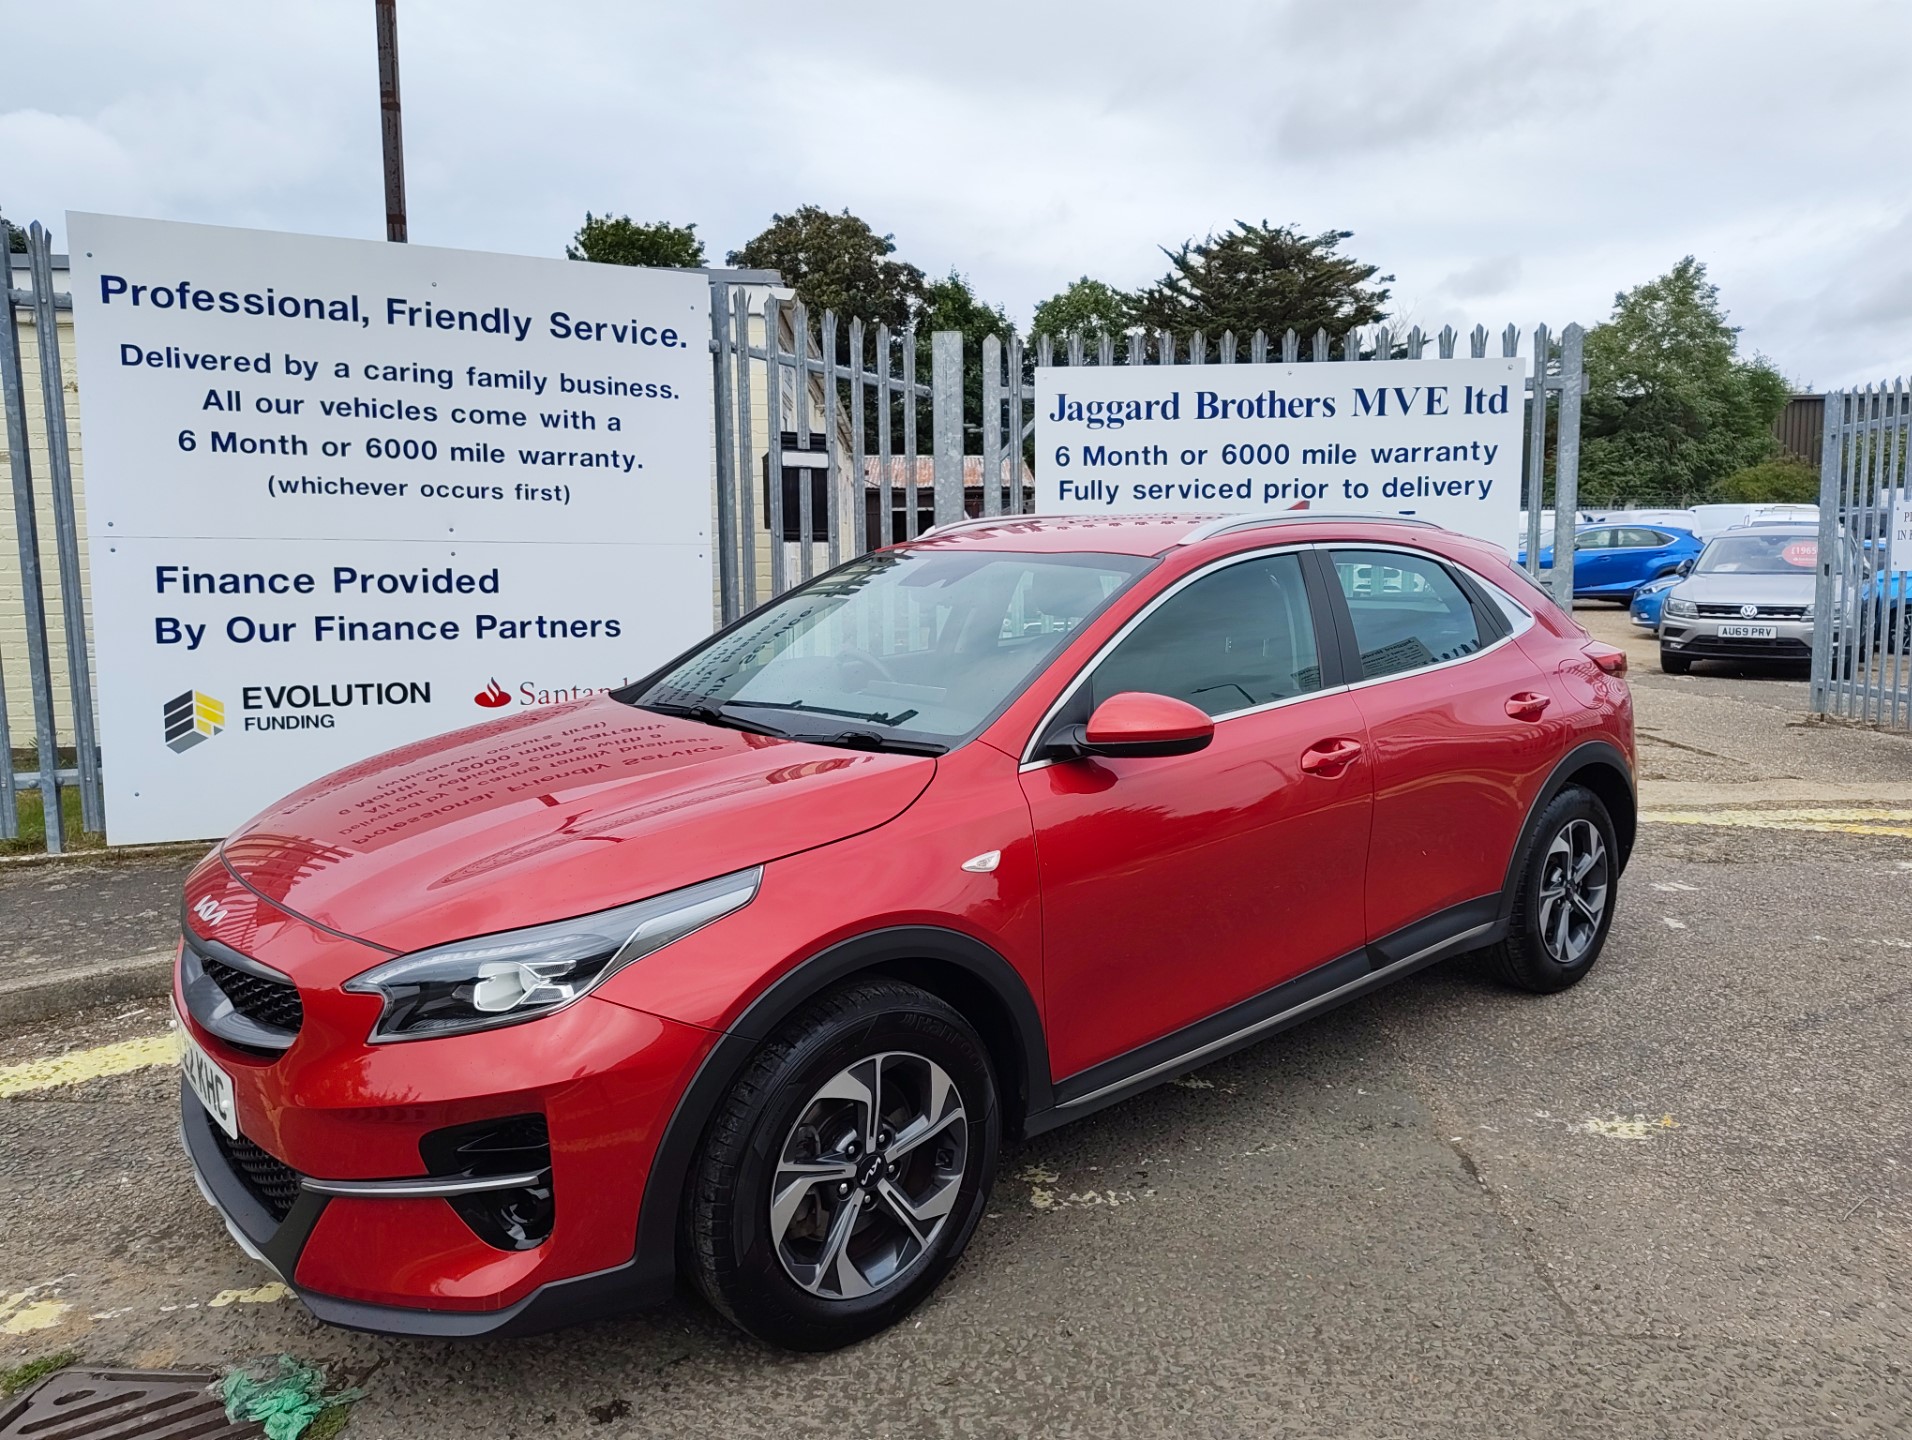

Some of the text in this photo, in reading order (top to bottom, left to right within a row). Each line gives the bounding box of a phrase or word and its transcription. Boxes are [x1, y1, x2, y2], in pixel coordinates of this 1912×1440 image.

[101, 275, 686, 348] Professional, Friendly Service.
[121, 344, 678, 399] Delivered by a caring family business.
[203, 389, 620, 431] All our vehicles come with a
[1050, 385, 1508, 429] Jaggard Brothers MVE ltd
[179, 430, 642, 473] 6 Month or 6000 mile warranty.
[1056, 441, 1498, 466] 6 Month or 6000 mile warranty
[269, 475, 570, 505] (whichever occurs first)
[1060, 476, 1492, 505] Fully serviced prior to delivery
[1903, 511, 1912, 523] P
[1897, 530, 1907, 541] IN
[156, 566, 499, 594] Finance Provided
[155, 615, 621, 650] By Our Finance Partners
[1722, 627, 1772, 637] AU69 PRV
[243, 682, 431, 710] EVOLUTION
[245, 714, 335, 731] FUNDING
[196, 1050, 227, 1121] KHC
